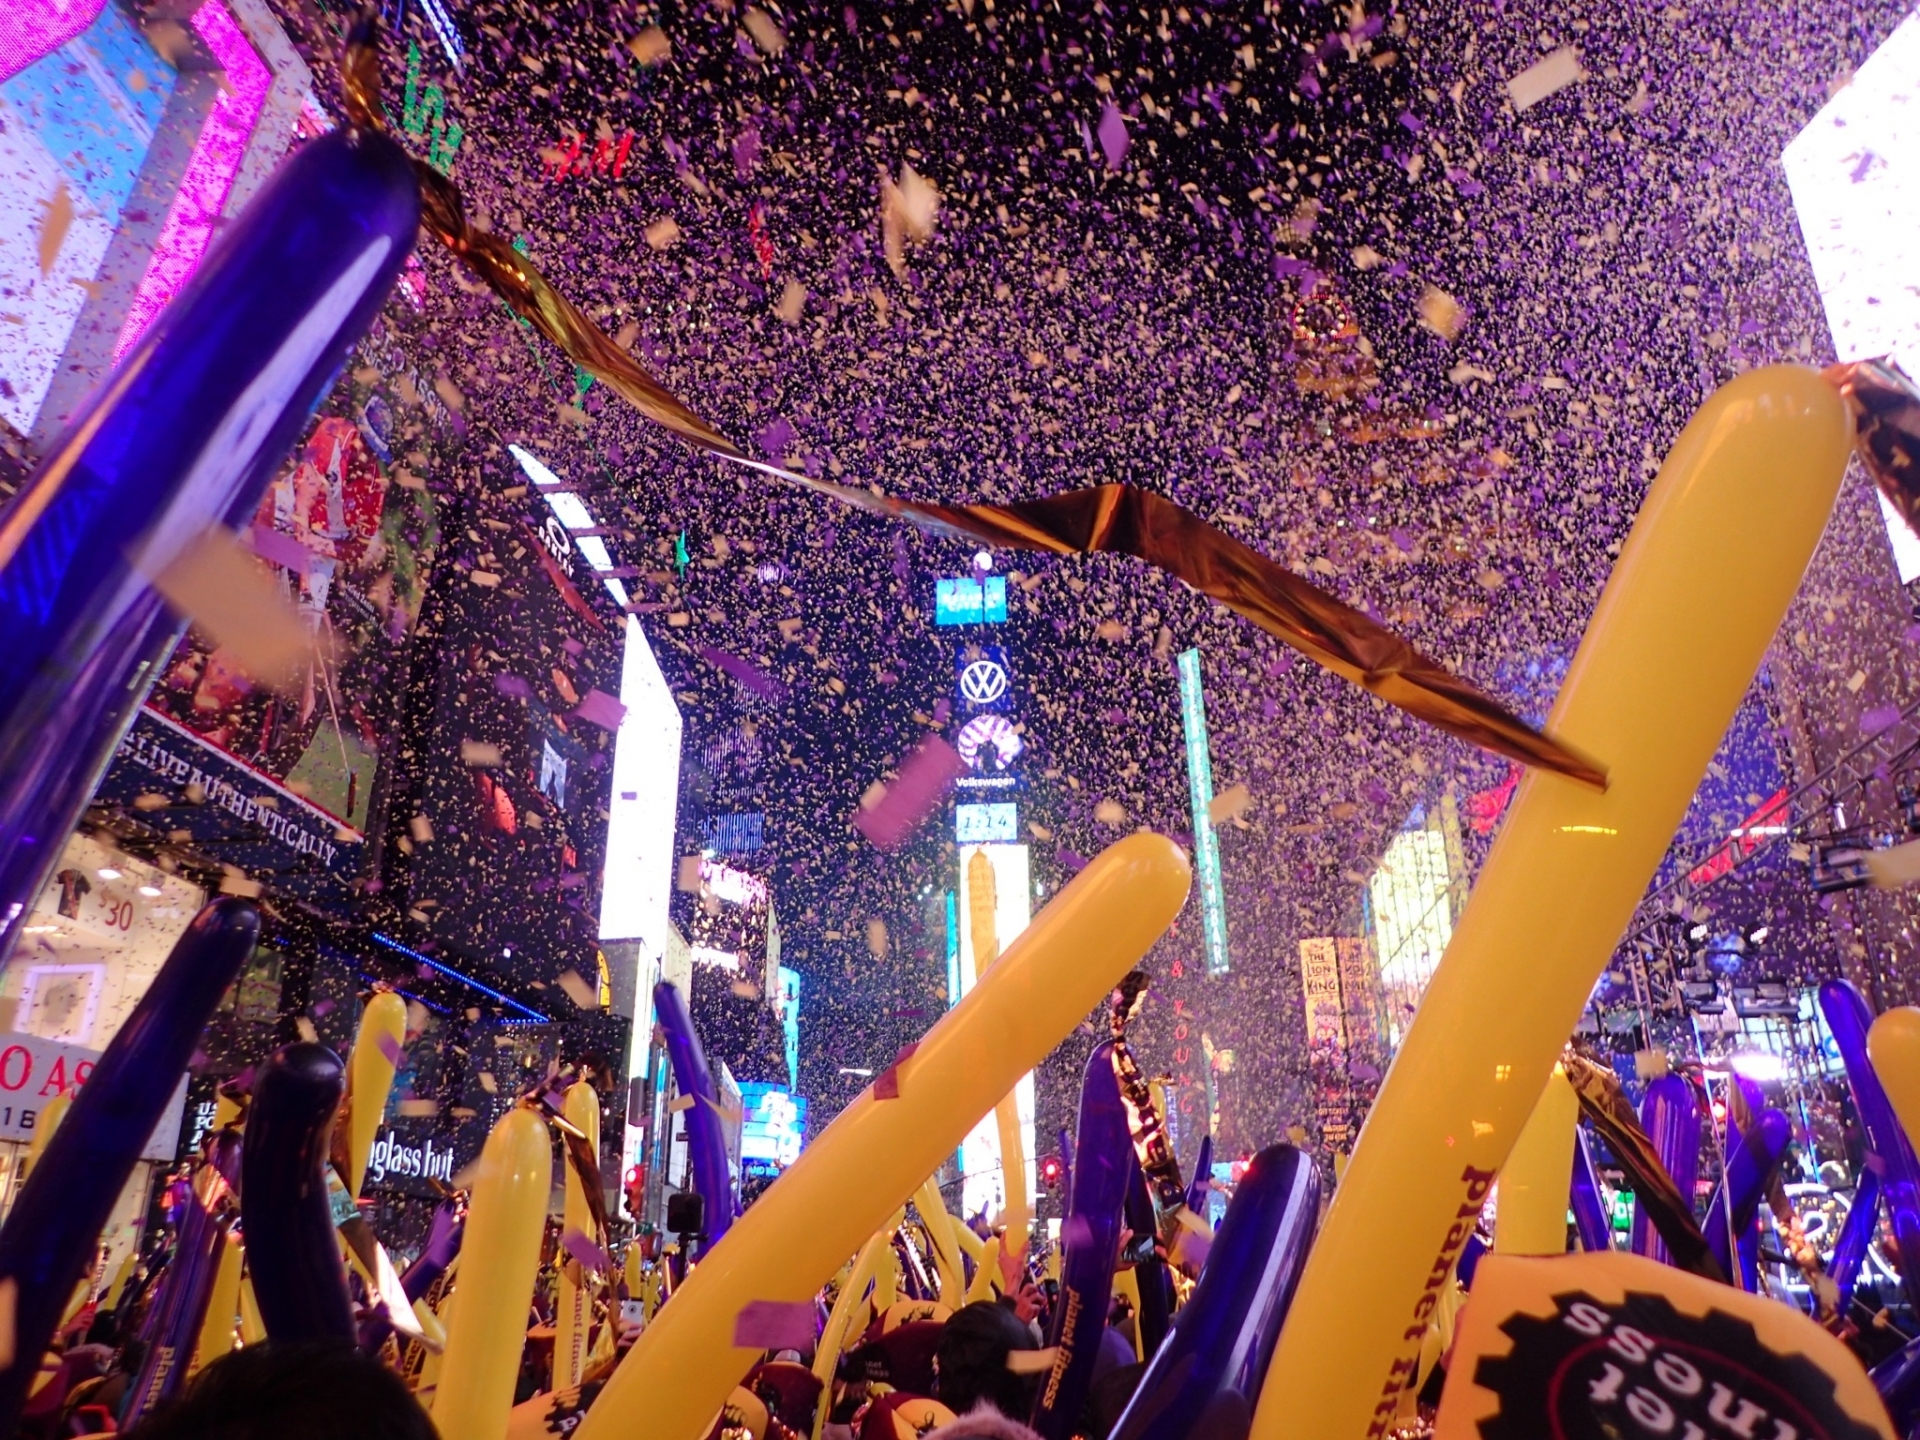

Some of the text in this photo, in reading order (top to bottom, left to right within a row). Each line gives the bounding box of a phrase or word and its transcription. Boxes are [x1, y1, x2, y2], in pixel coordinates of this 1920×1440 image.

[1307, 962, 1331, 977] LION
[1307, 979, 1336, 996] KING
[423, 1139, 455, 1182] hut
[1404, 1164, 1497, 1341] planet
[570, 1332, 584, 1385] fitness
[1042, 1285, 1083, 1410] planet fitness
